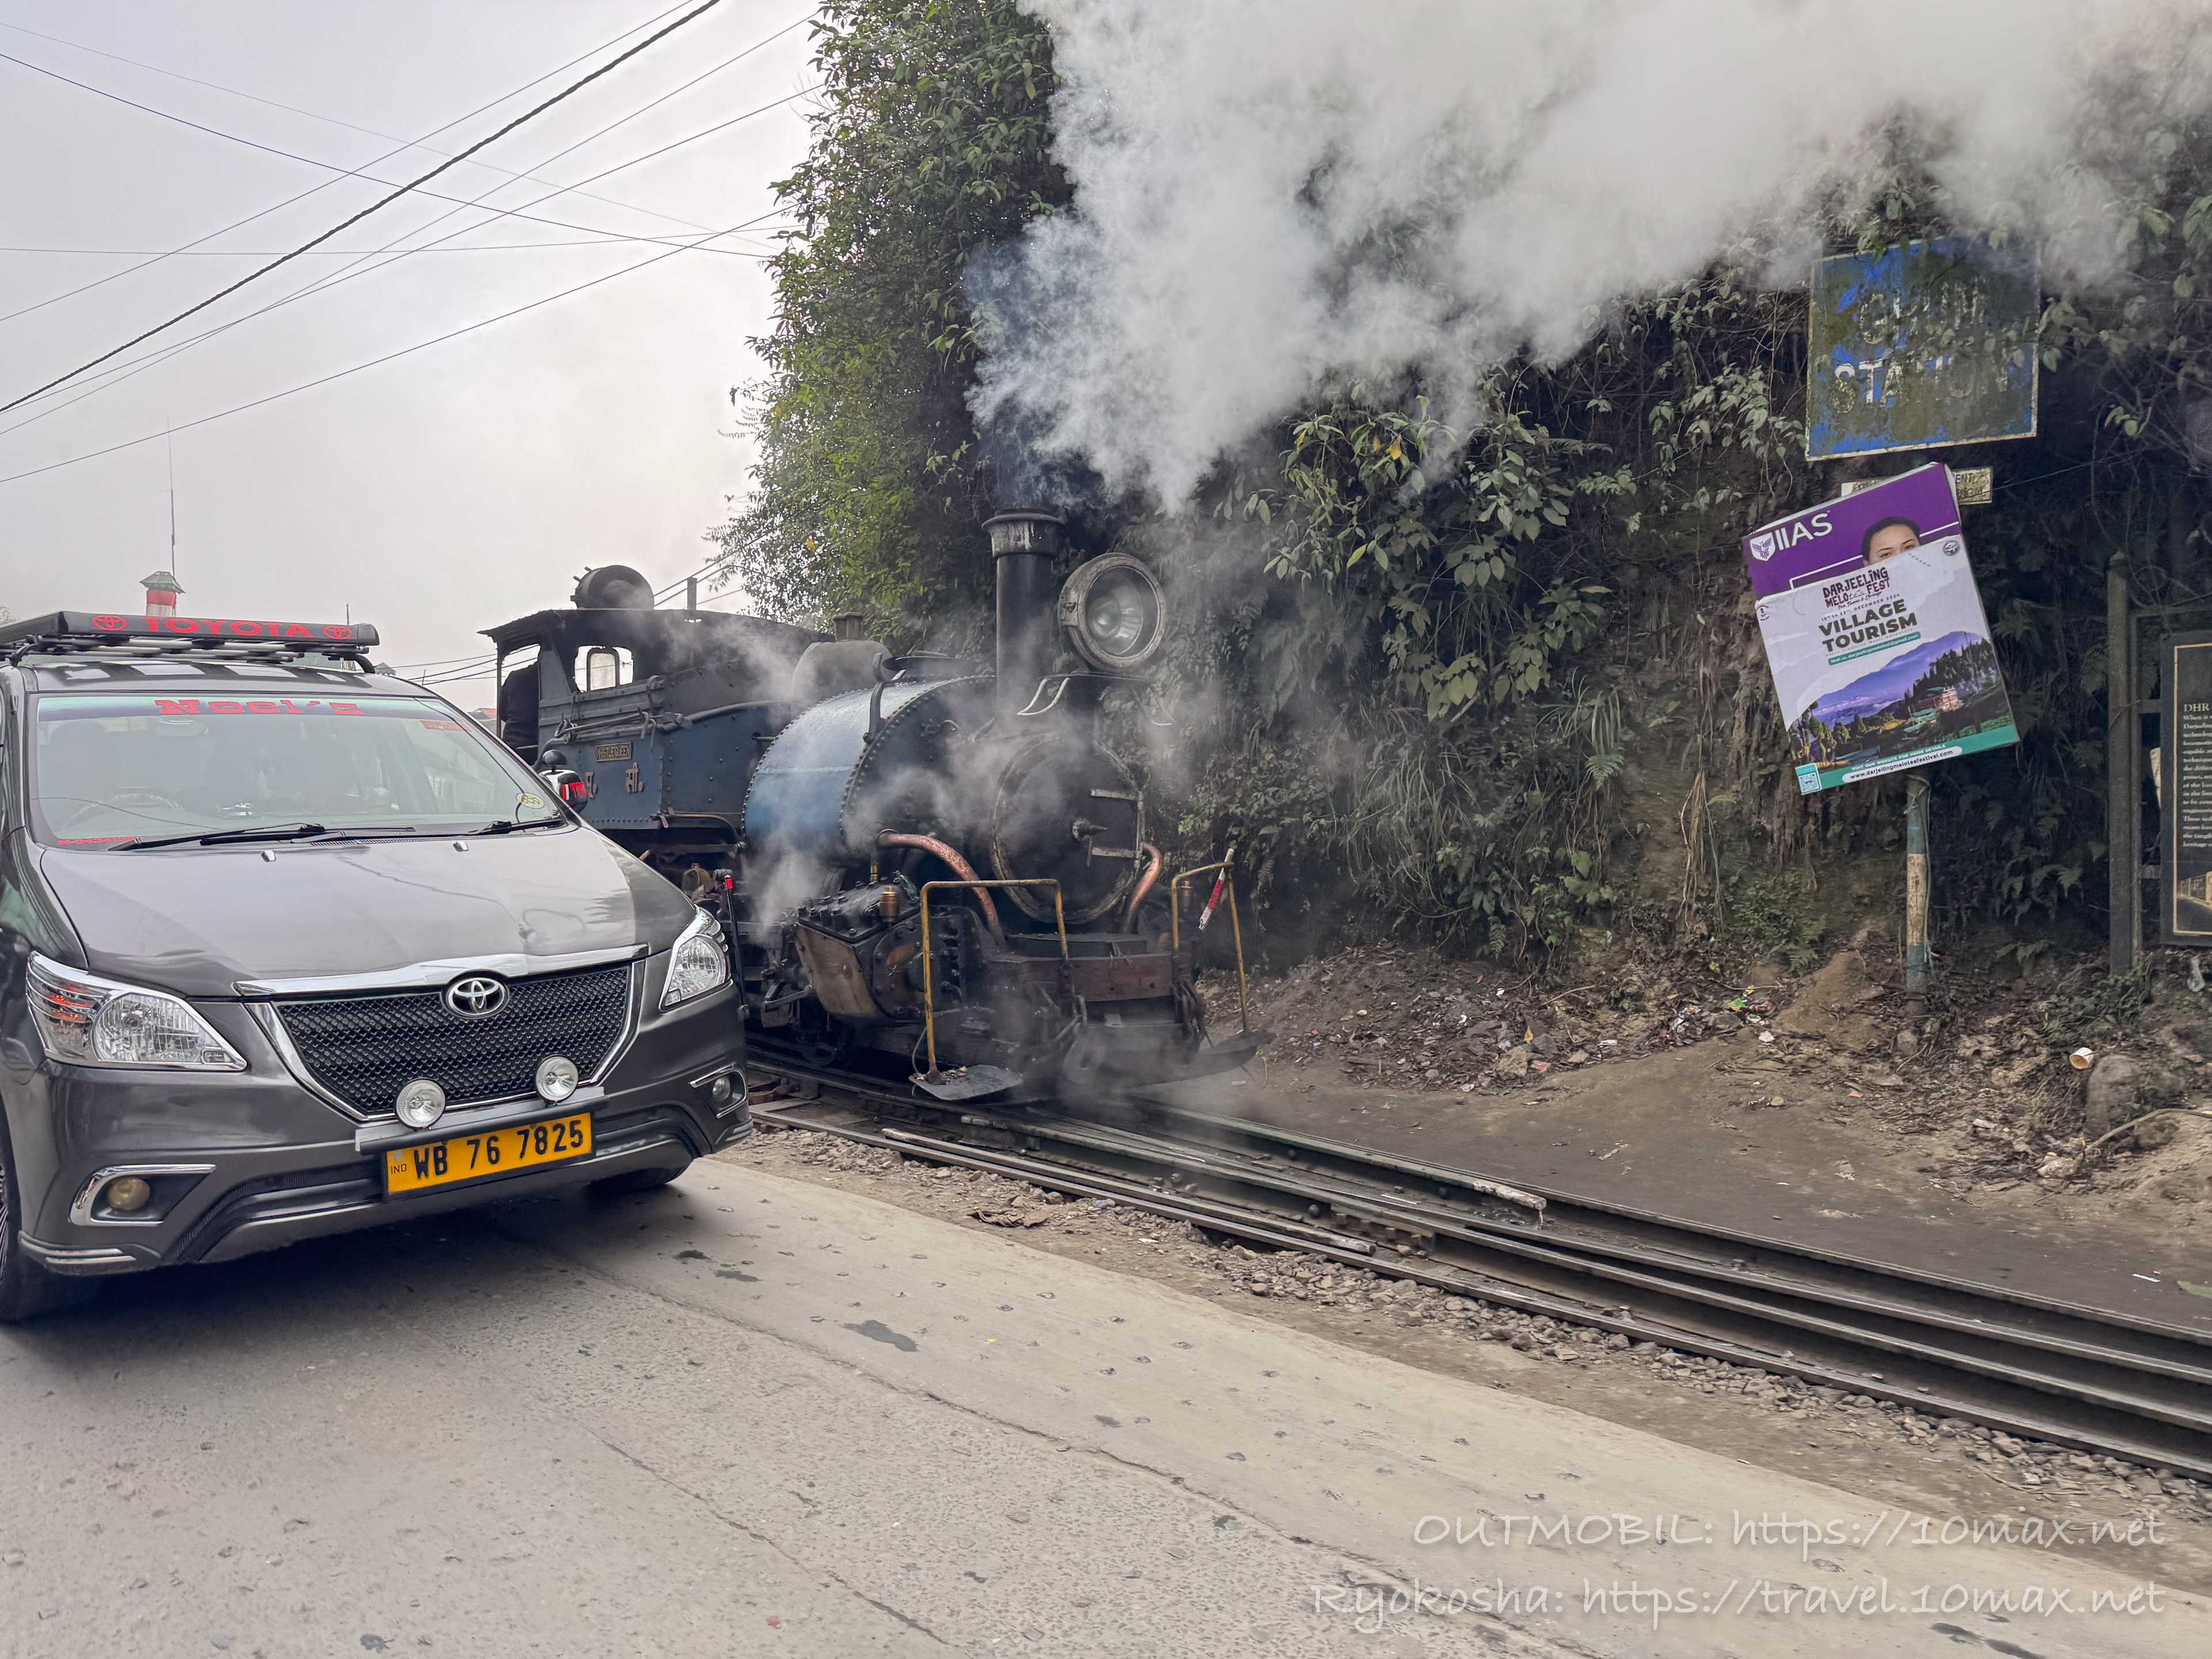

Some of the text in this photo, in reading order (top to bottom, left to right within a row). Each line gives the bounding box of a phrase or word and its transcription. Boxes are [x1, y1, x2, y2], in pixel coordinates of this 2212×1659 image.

[1775, 513, 1832, 551] IIAS
[1866, 577, 1890, 595] FEST
[141, 616, 313, 638] TOYOTA
[1818, 599, 1907, 637] VILLAGE
[1822, 612, 1918, 652] TOURISM
[391, 1120, 584, 1181] IND WB 76 7825
